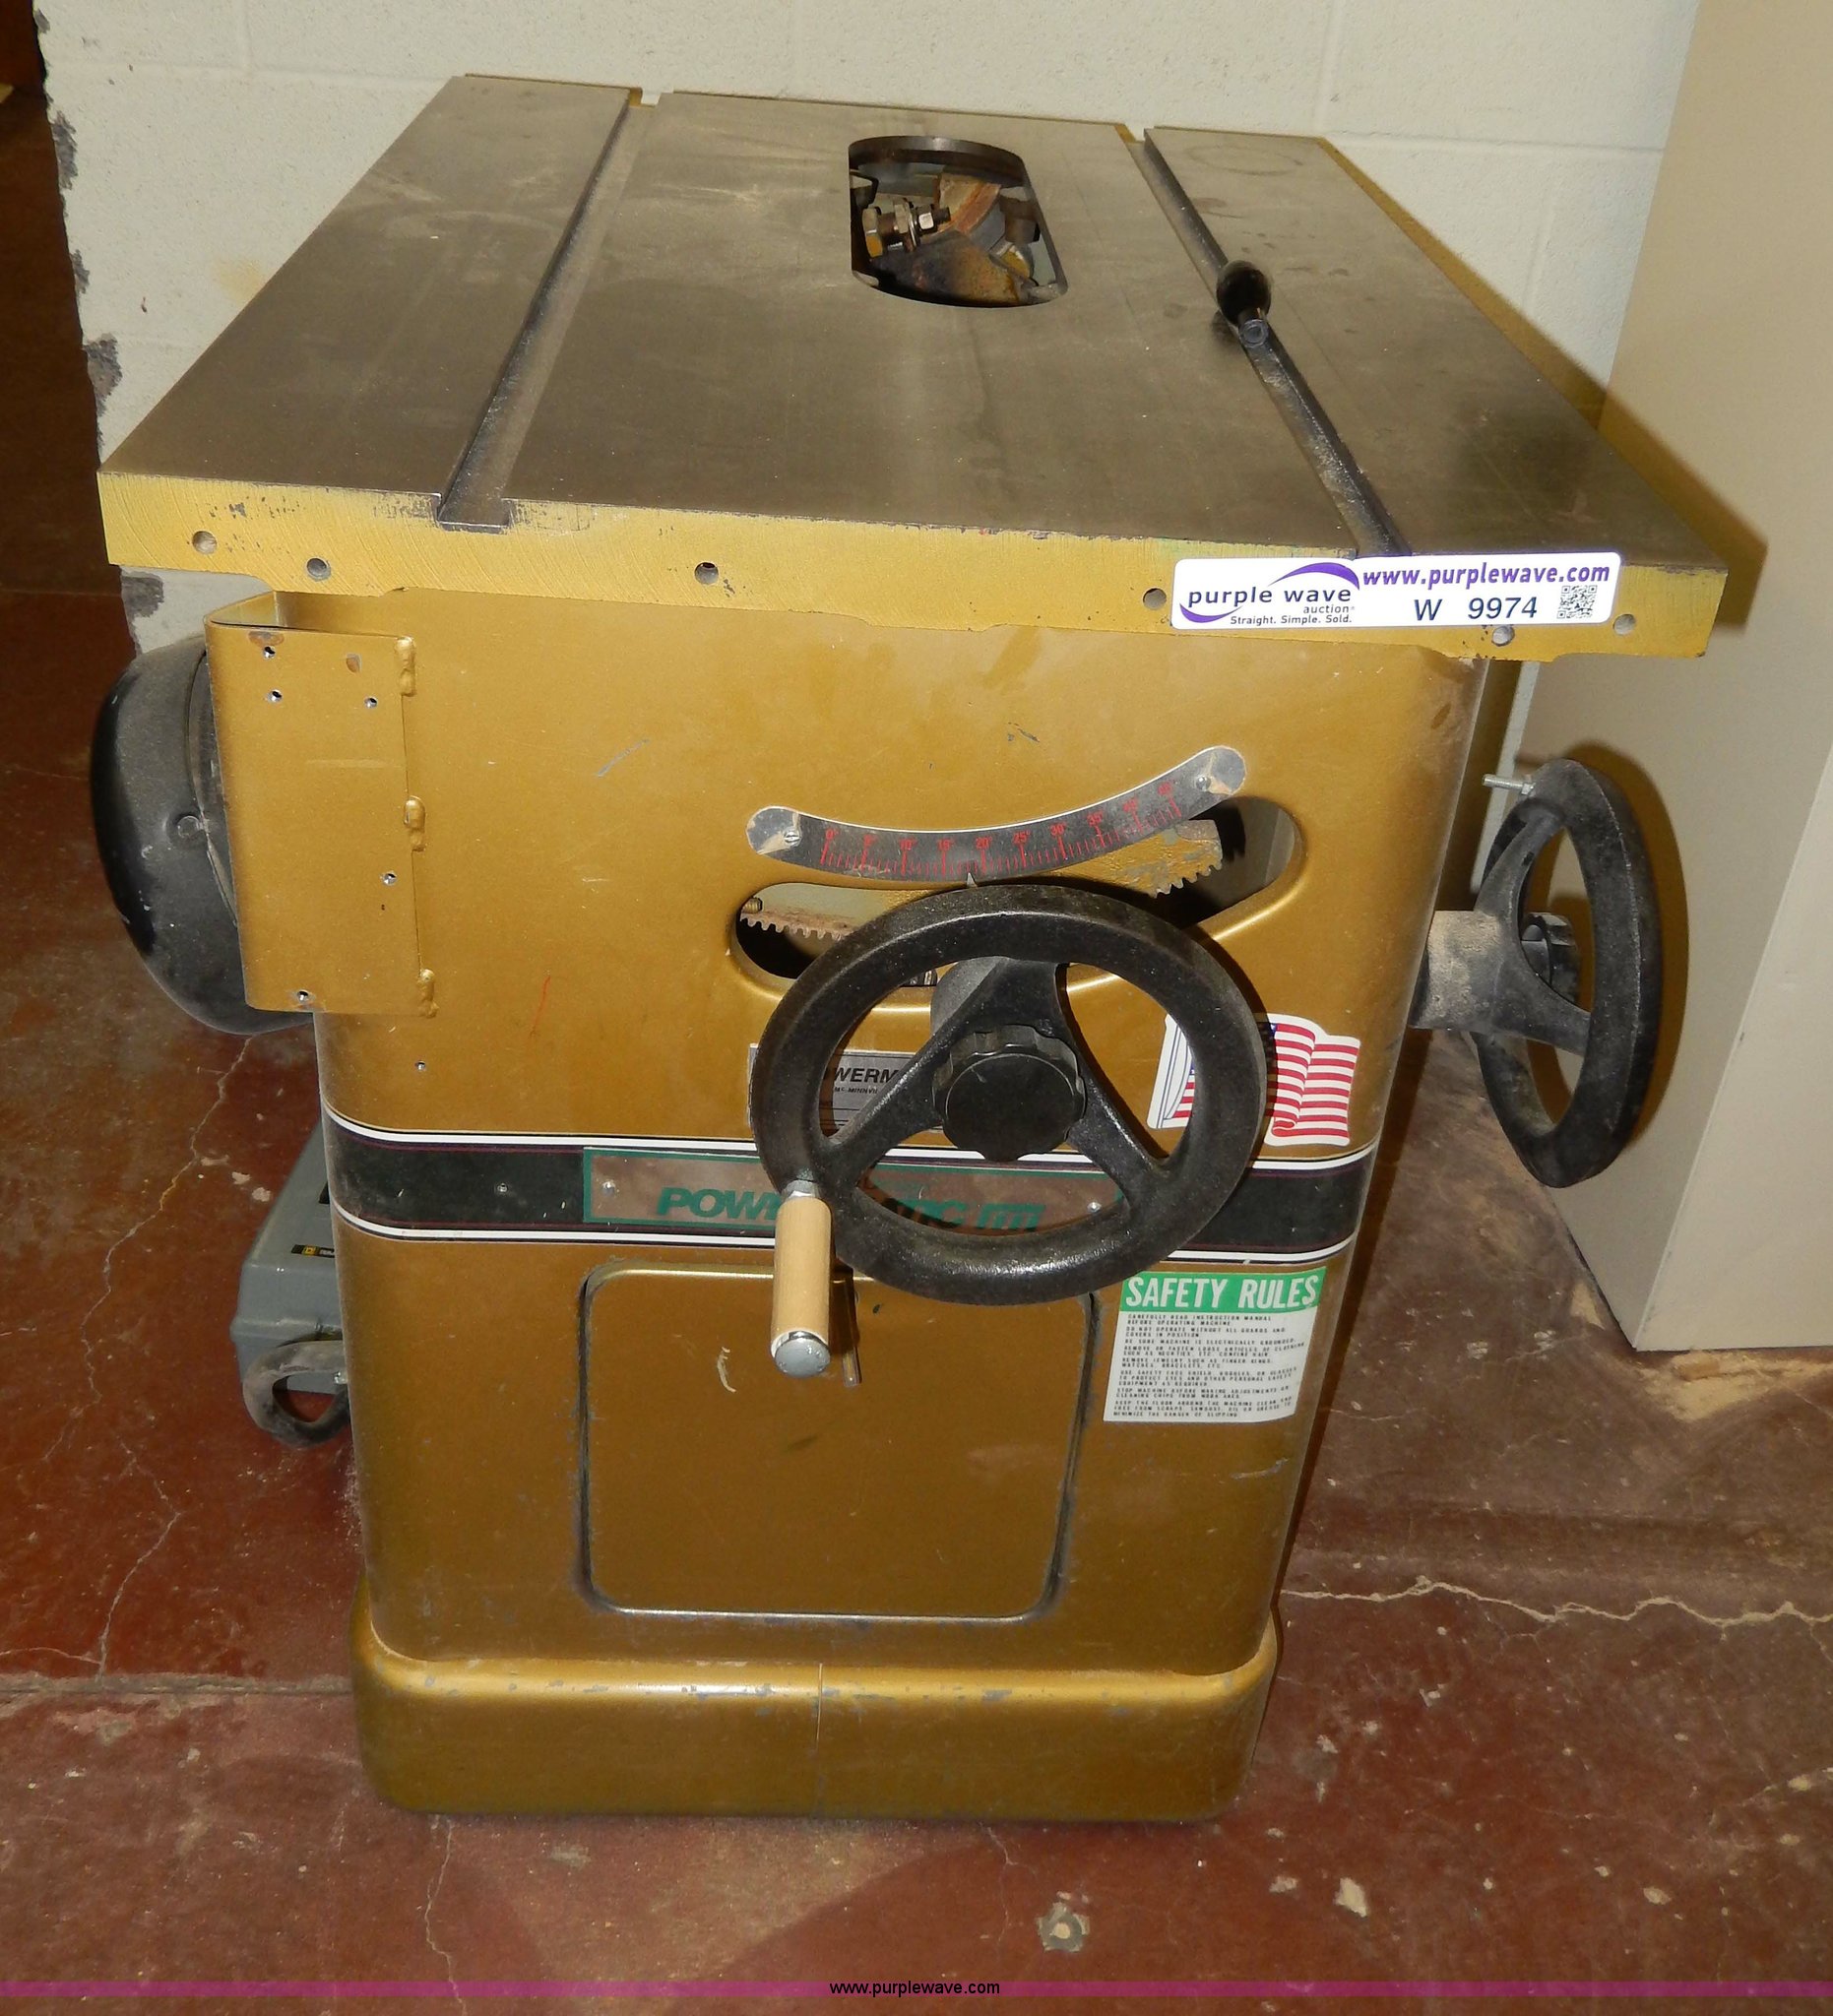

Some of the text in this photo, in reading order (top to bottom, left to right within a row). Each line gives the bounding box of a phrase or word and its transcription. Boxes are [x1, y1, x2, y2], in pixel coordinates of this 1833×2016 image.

[1362, 562, 1611, 590] www.purplewave.com
[1188, 587, 1352, 607] purple wave
[1414, 597, 1539, 621] W 9974
[1230, 614, 1352, 627] Straight. Simple. Sold.
[1125, 1275, 1319, 1310] SAFETY RULES
